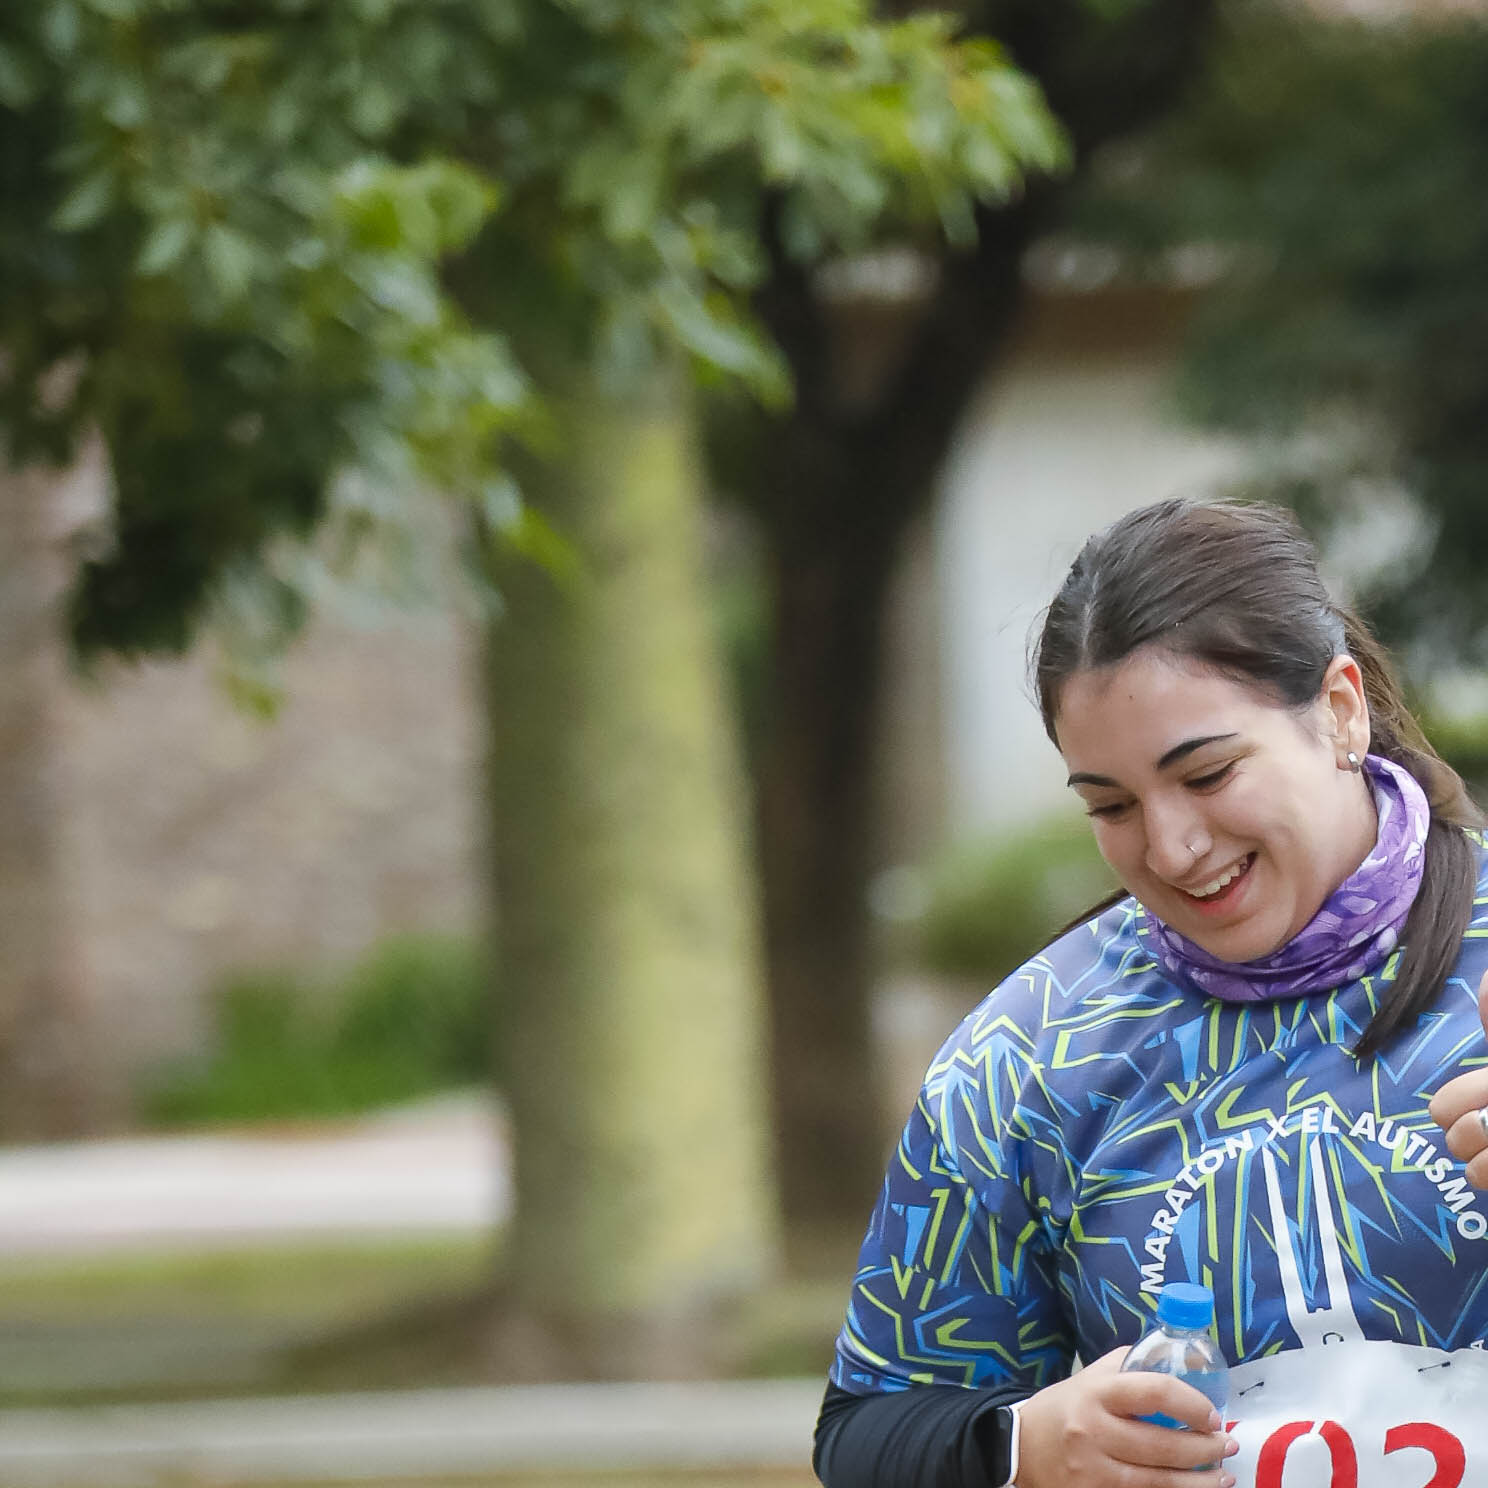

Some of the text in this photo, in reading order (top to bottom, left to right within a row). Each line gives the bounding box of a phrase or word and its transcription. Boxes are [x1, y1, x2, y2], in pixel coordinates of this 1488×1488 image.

[1140, 1106, 1488, 1295] MARATÓN X EL AUTISMO
